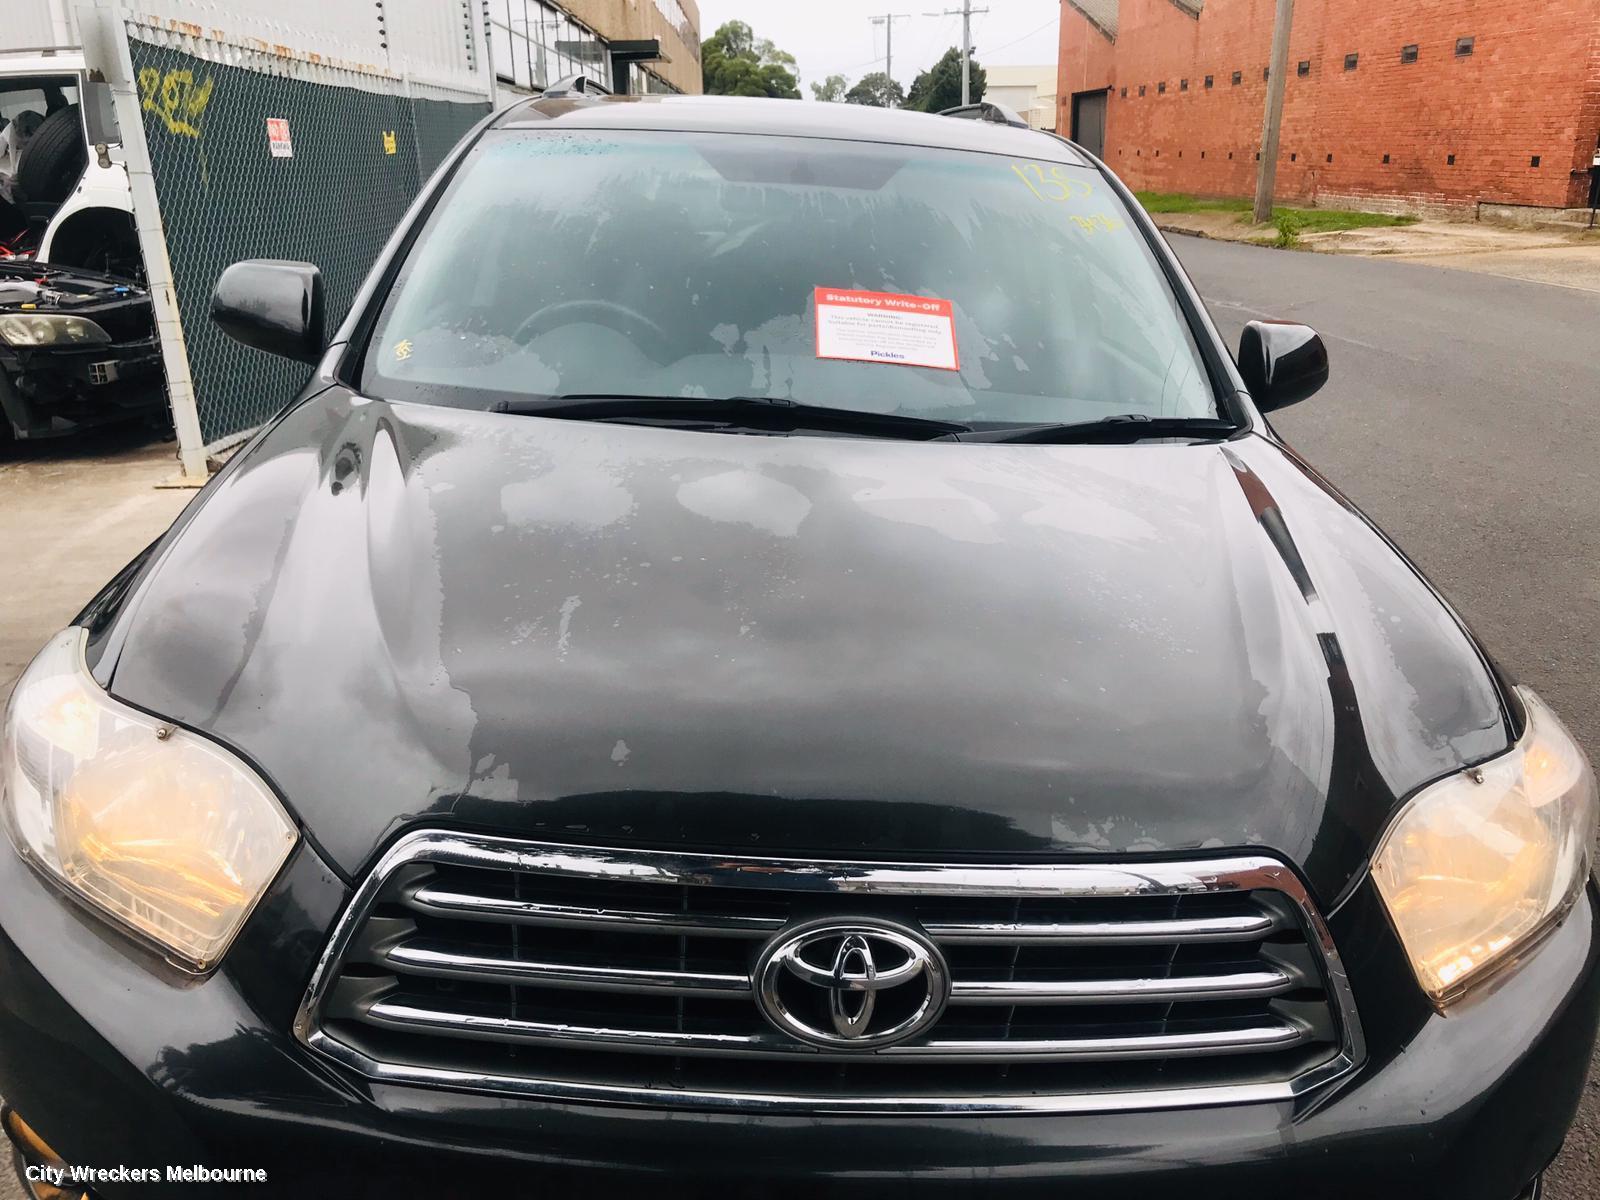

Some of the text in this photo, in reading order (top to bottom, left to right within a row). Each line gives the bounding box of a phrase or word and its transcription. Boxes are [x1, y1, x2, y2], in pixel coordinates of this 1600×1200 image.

[826, 293, 940, 311] Statutory Write-Off
[870, 350, 905, 359] Pickles
